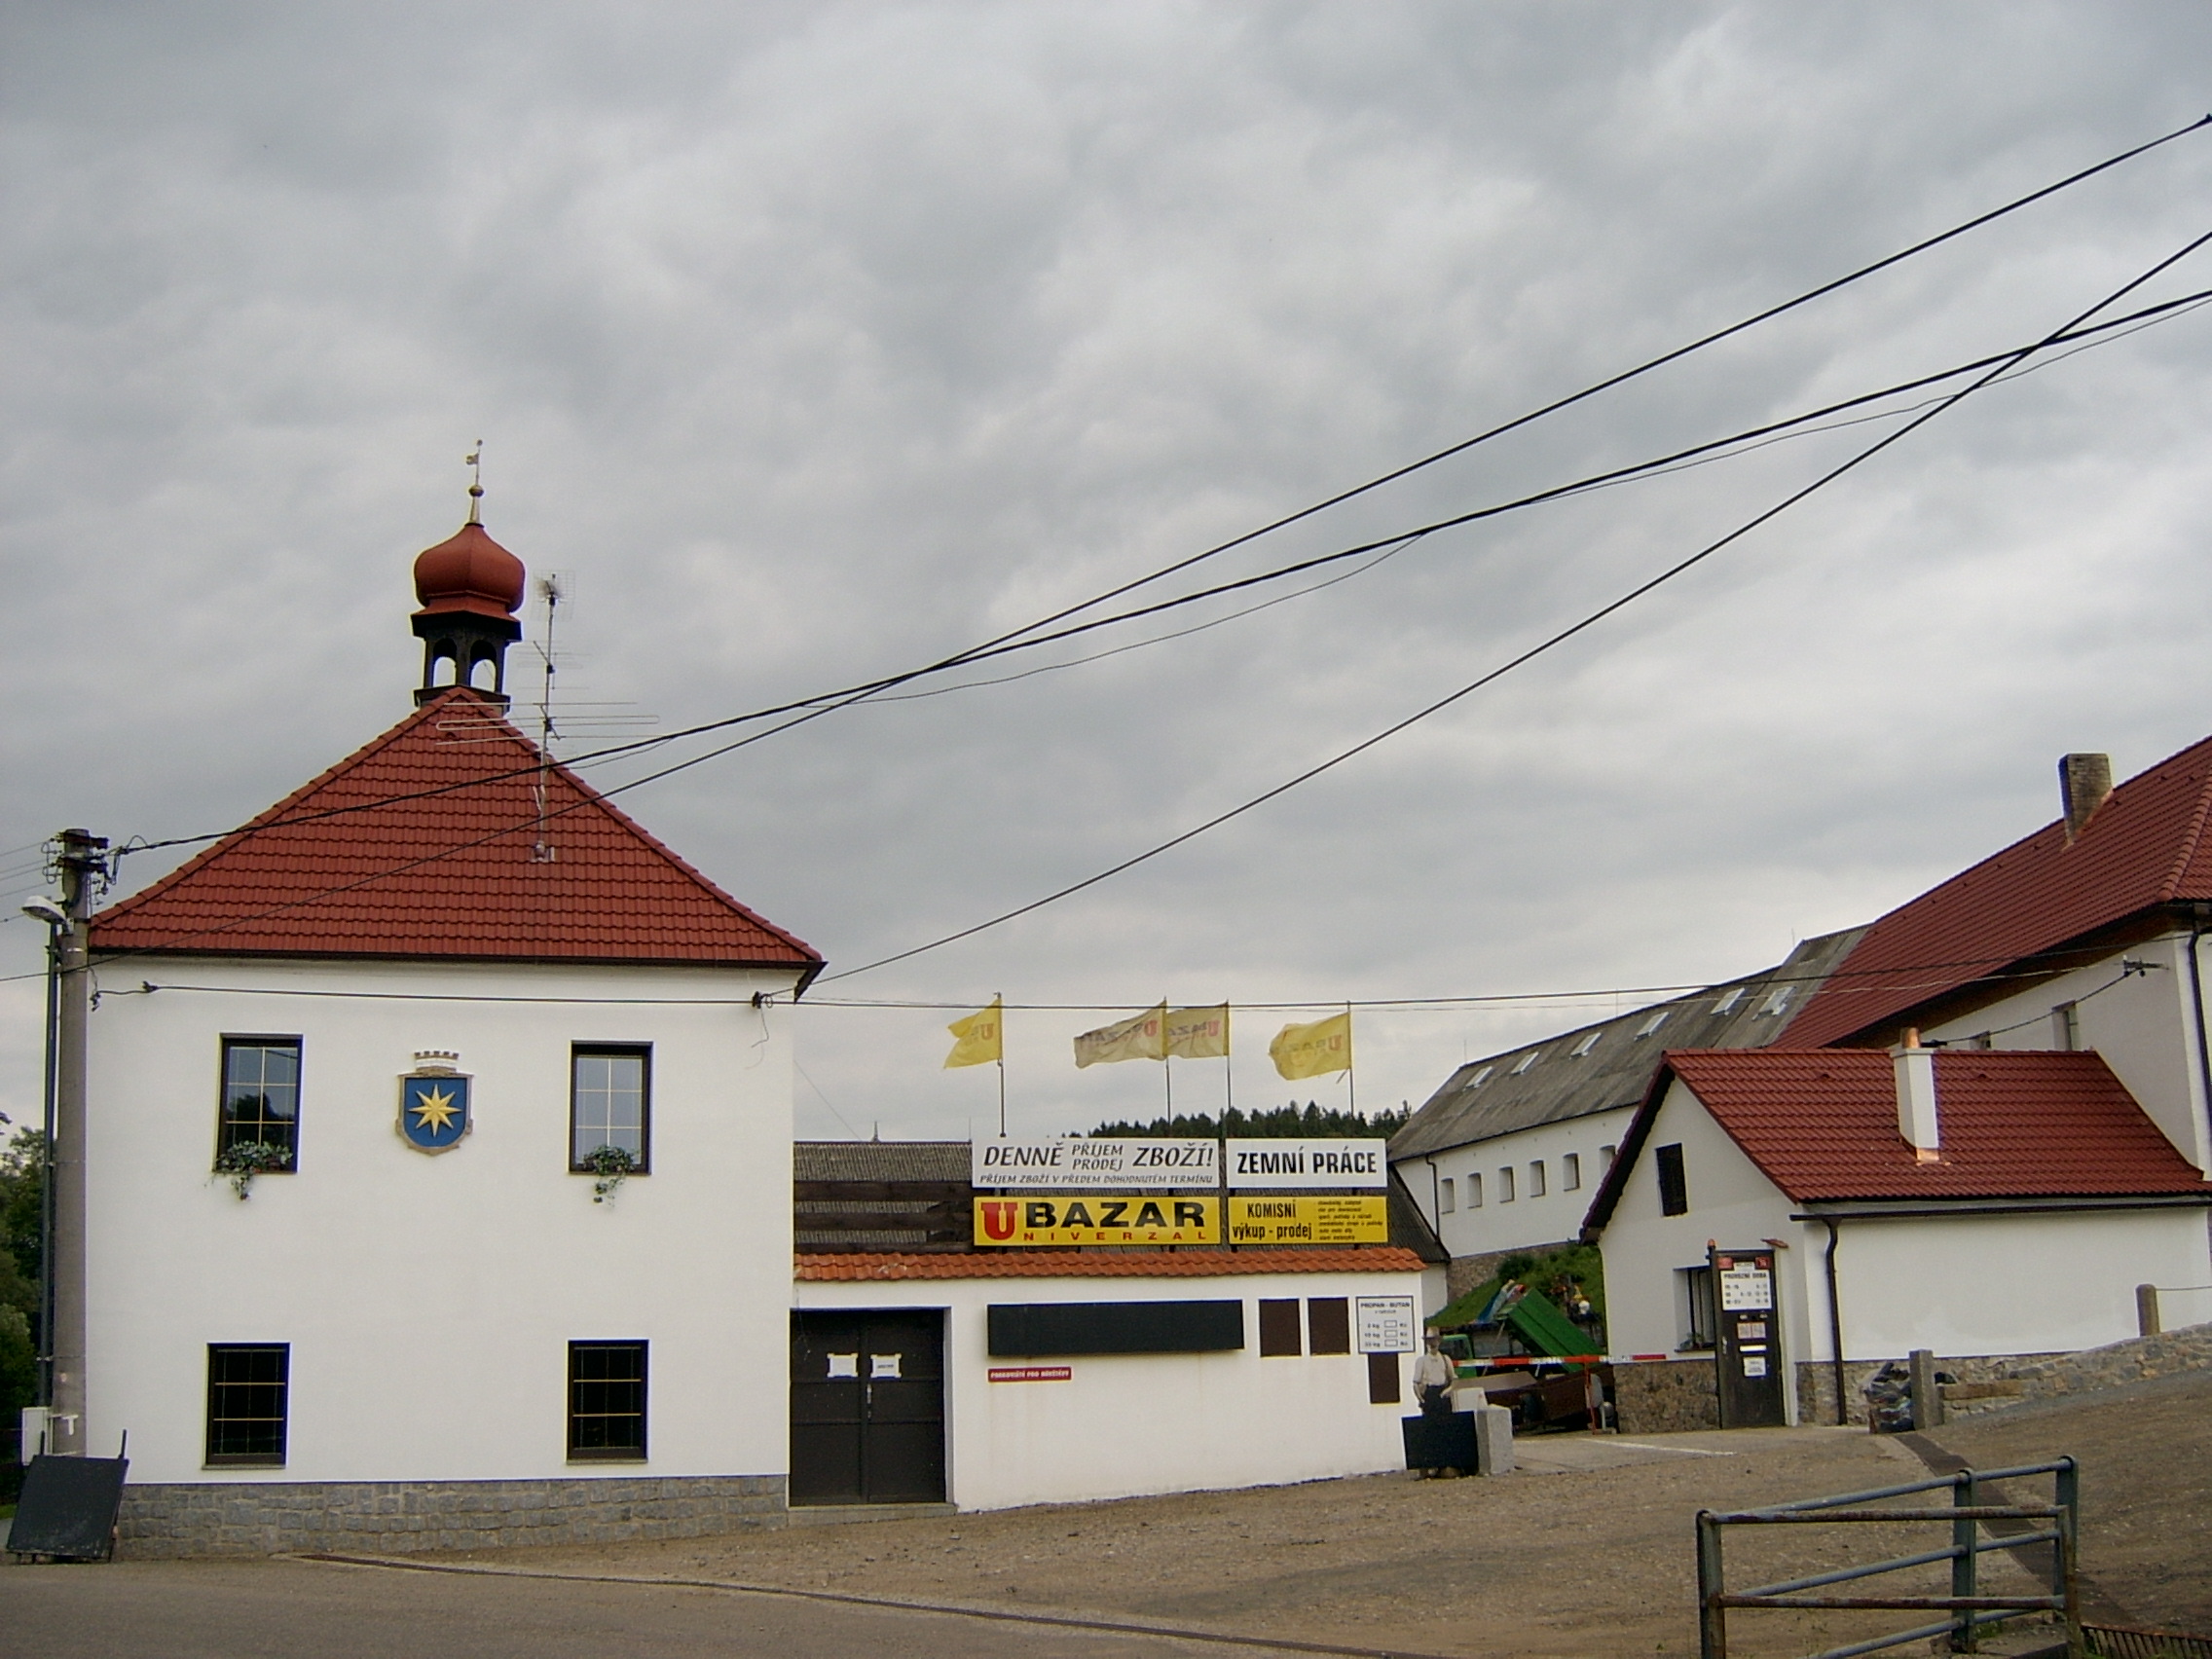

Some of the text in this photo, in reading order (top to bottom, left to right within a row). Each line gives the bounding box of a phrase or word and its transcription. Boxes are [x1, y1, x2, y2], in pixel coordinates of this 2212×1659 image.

[983, 1141, 1214, 1167] DENNĚ ZBOŽÍ!
[1072, 1142, 1124, 1158] PŘÍJEM
[1072, 1158, 1124, 1172] PRODEJ
[1236, 1145, 1378, 1174] ZEMNÍ PRÁCE
[979, 1173, 1016, 1185] PŘÍJEM
[1019, 1173, 1050, 1184] ZBOŽÍ
[1051, 1175, 1059, 1184] V
[1061, 1174, 1101, 1184] PŘEDEM
[1169, 1173, 1213, 1184] TERMÍNU
[1247, 1199, 1297, 1218] KOMISNÍ
[1232, 1223, 1266, 1241] výkup
[1276, 1223, 1312, 1241] prodej
